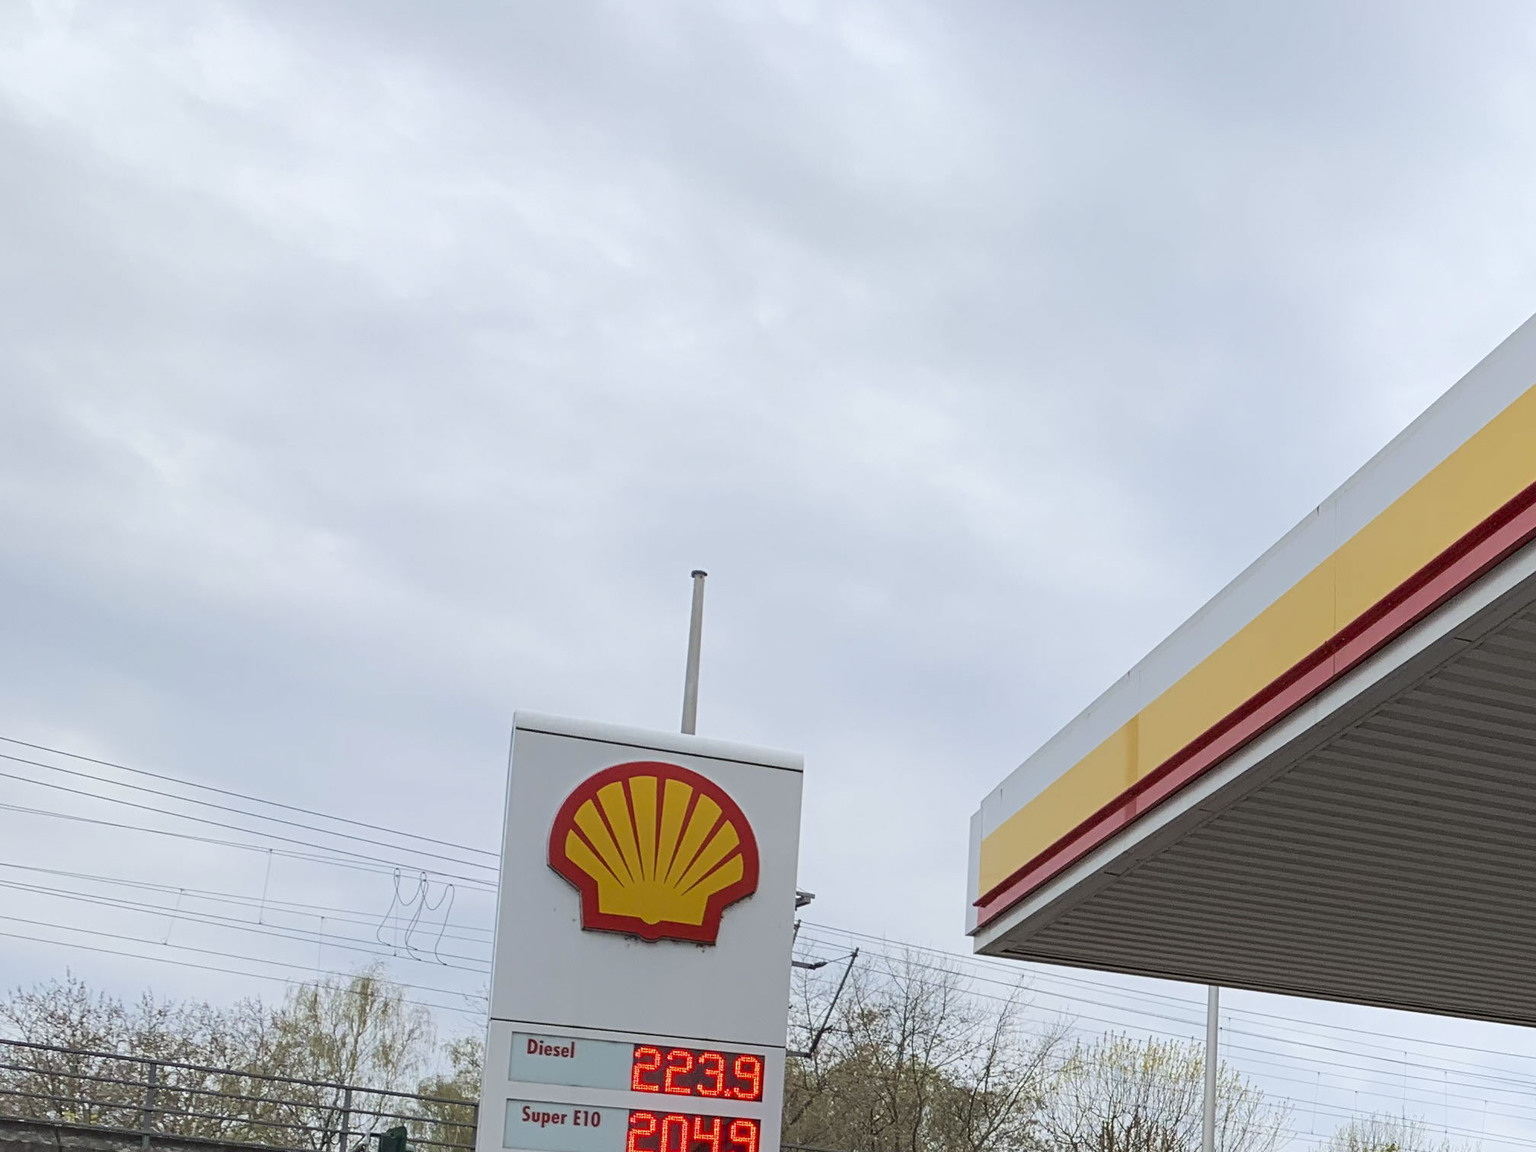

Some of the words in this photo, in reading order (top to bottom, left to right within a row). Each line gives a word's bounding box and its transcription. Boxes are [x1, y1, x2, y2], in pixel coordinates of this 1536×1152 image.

[526, 1039, 575, 1059] Diesel
[522, 1106, 568, 1128] Super
[573, 1110, 601, 1128] E10
